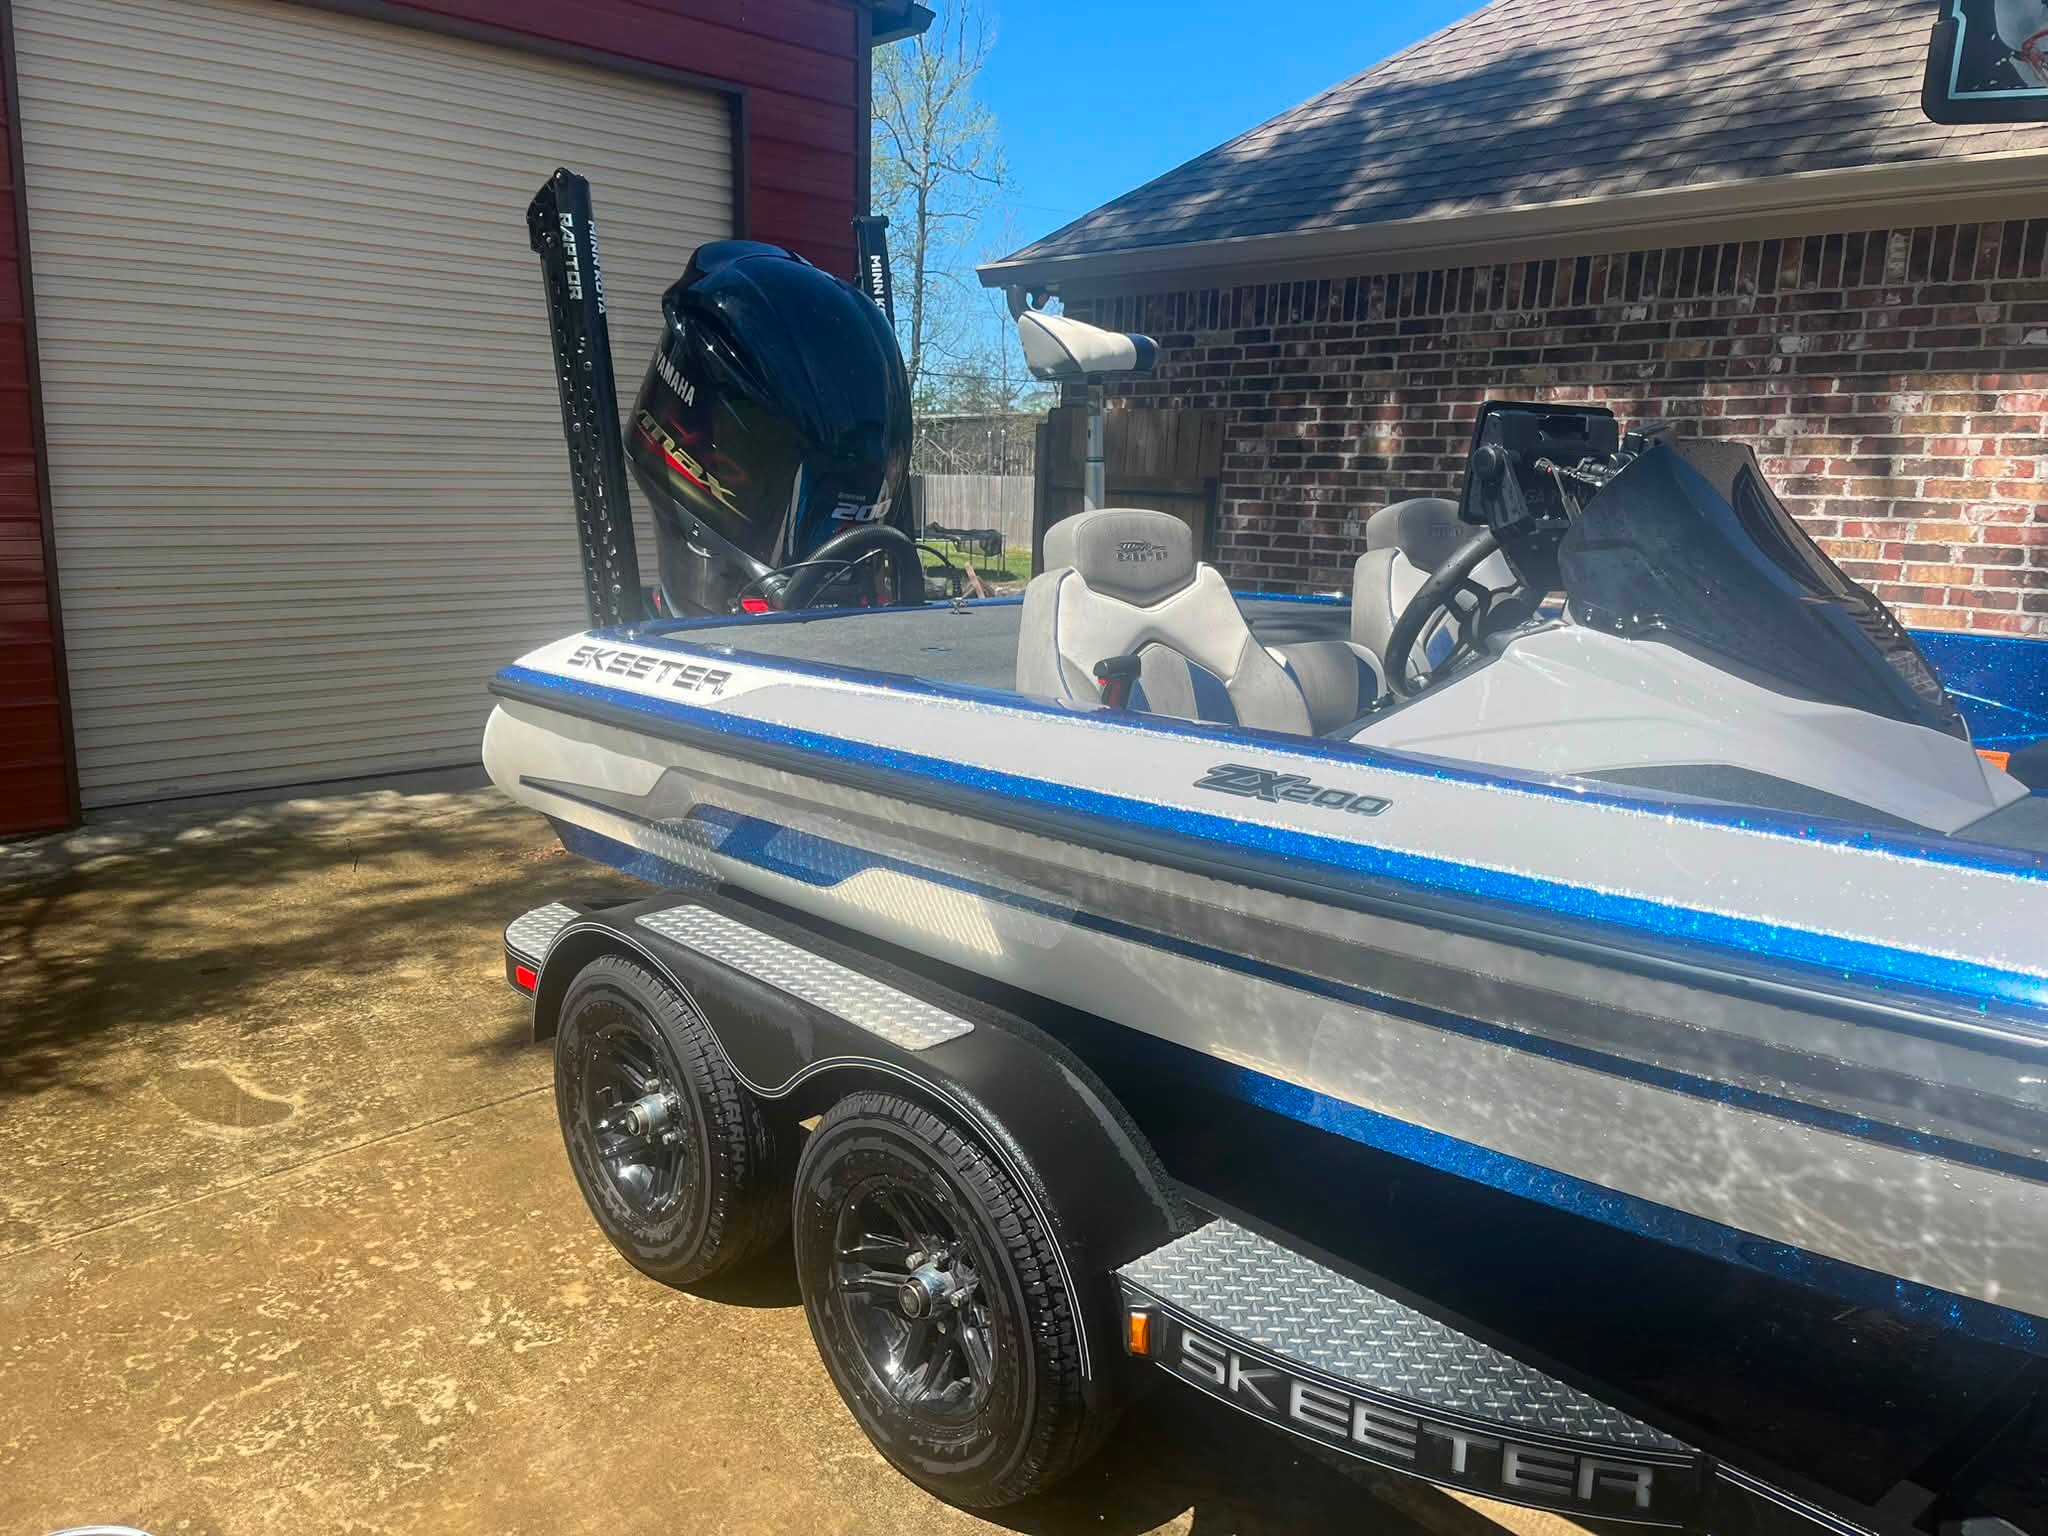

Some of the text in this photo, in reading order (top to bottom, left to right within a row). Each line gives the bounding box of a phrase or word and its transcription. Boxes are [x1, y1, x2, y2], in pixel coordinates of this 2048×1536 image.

[559, 212, 583, 300] RAPTOR
[587, 219, 607, 315] MINN KOTA
[870, 254, 884, 295] MINN
[831, 498, 892, 520] 200
[567, 645, 733, 696] SKEETER
[1193, 763, 1394, 817] ZX200
[1181, 1329, 1655, 1508] SKEETER
